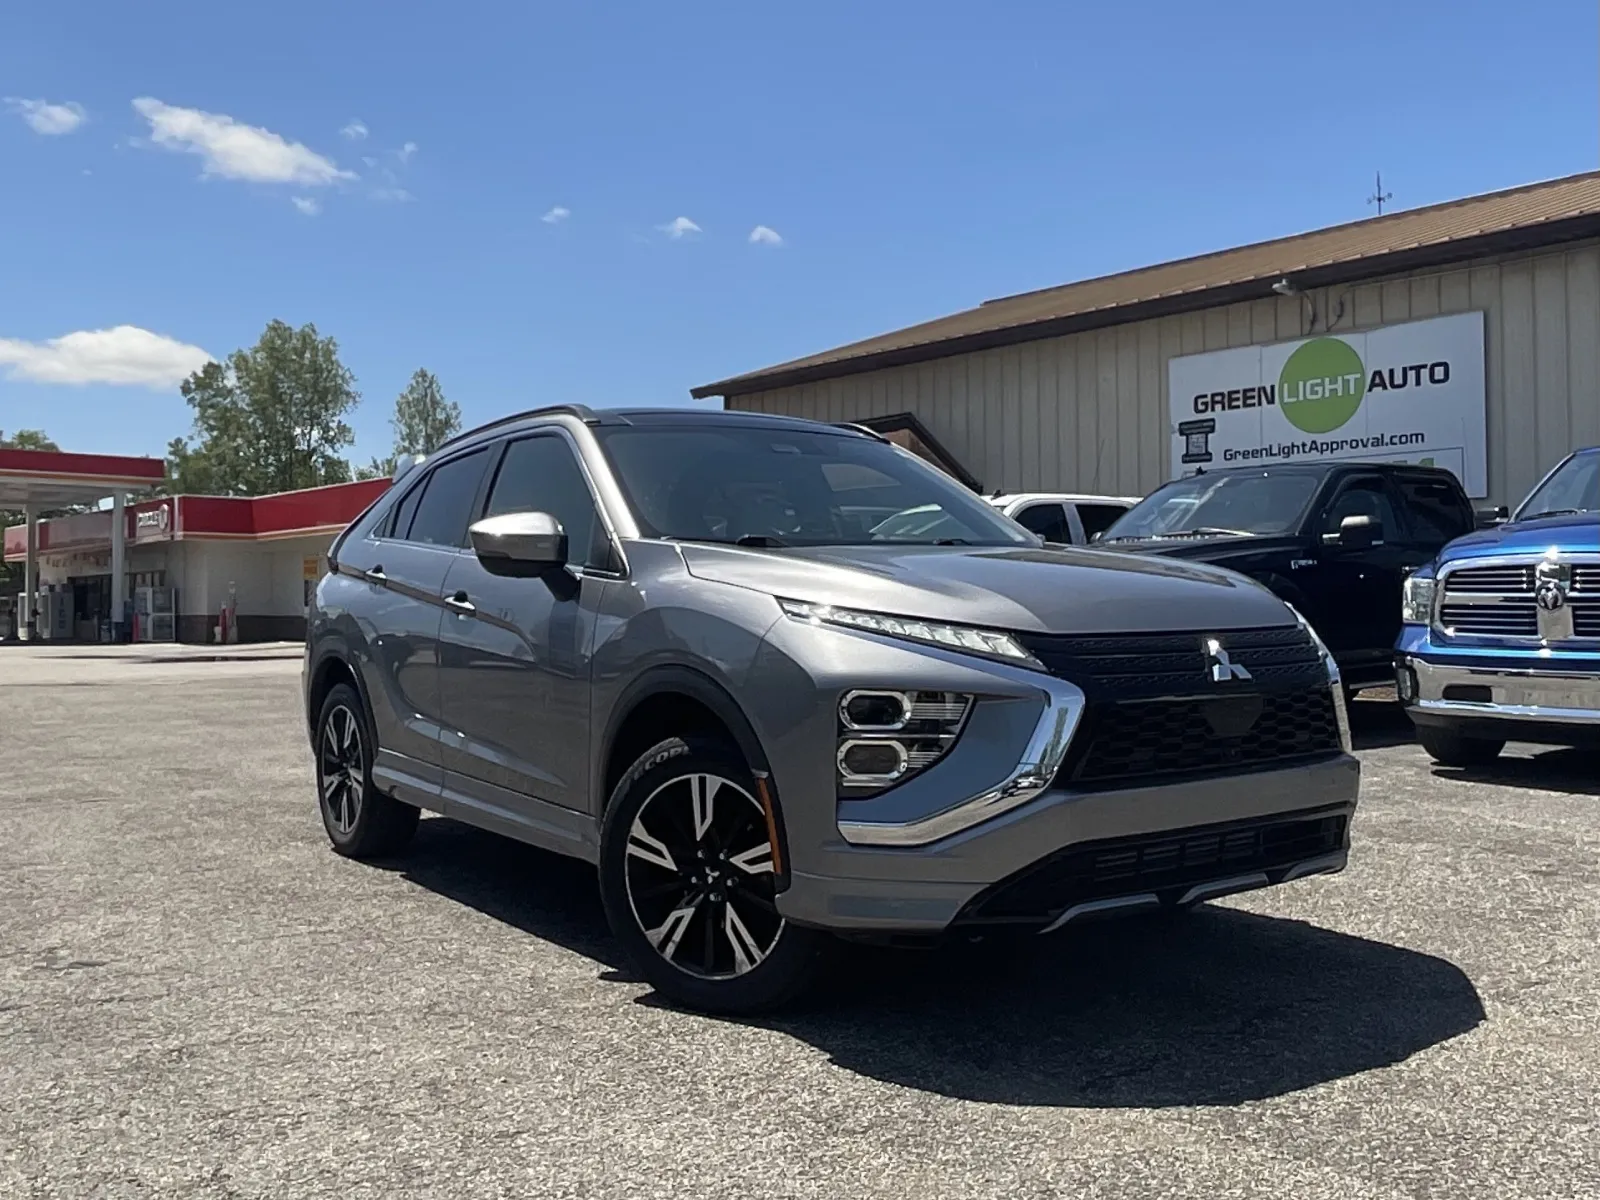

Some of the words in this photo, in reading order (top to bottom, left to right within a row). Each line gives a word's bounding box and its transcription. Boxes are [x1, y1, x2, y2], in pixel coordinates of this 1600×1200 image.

[1193, 384, 1276, 414] GREEN
[1283, 373, 1361, 403] LIGHT
[1367, 361, 1450, 393] AUTO
[1223, 432, 1425, 461] GreenLightApproval.com
